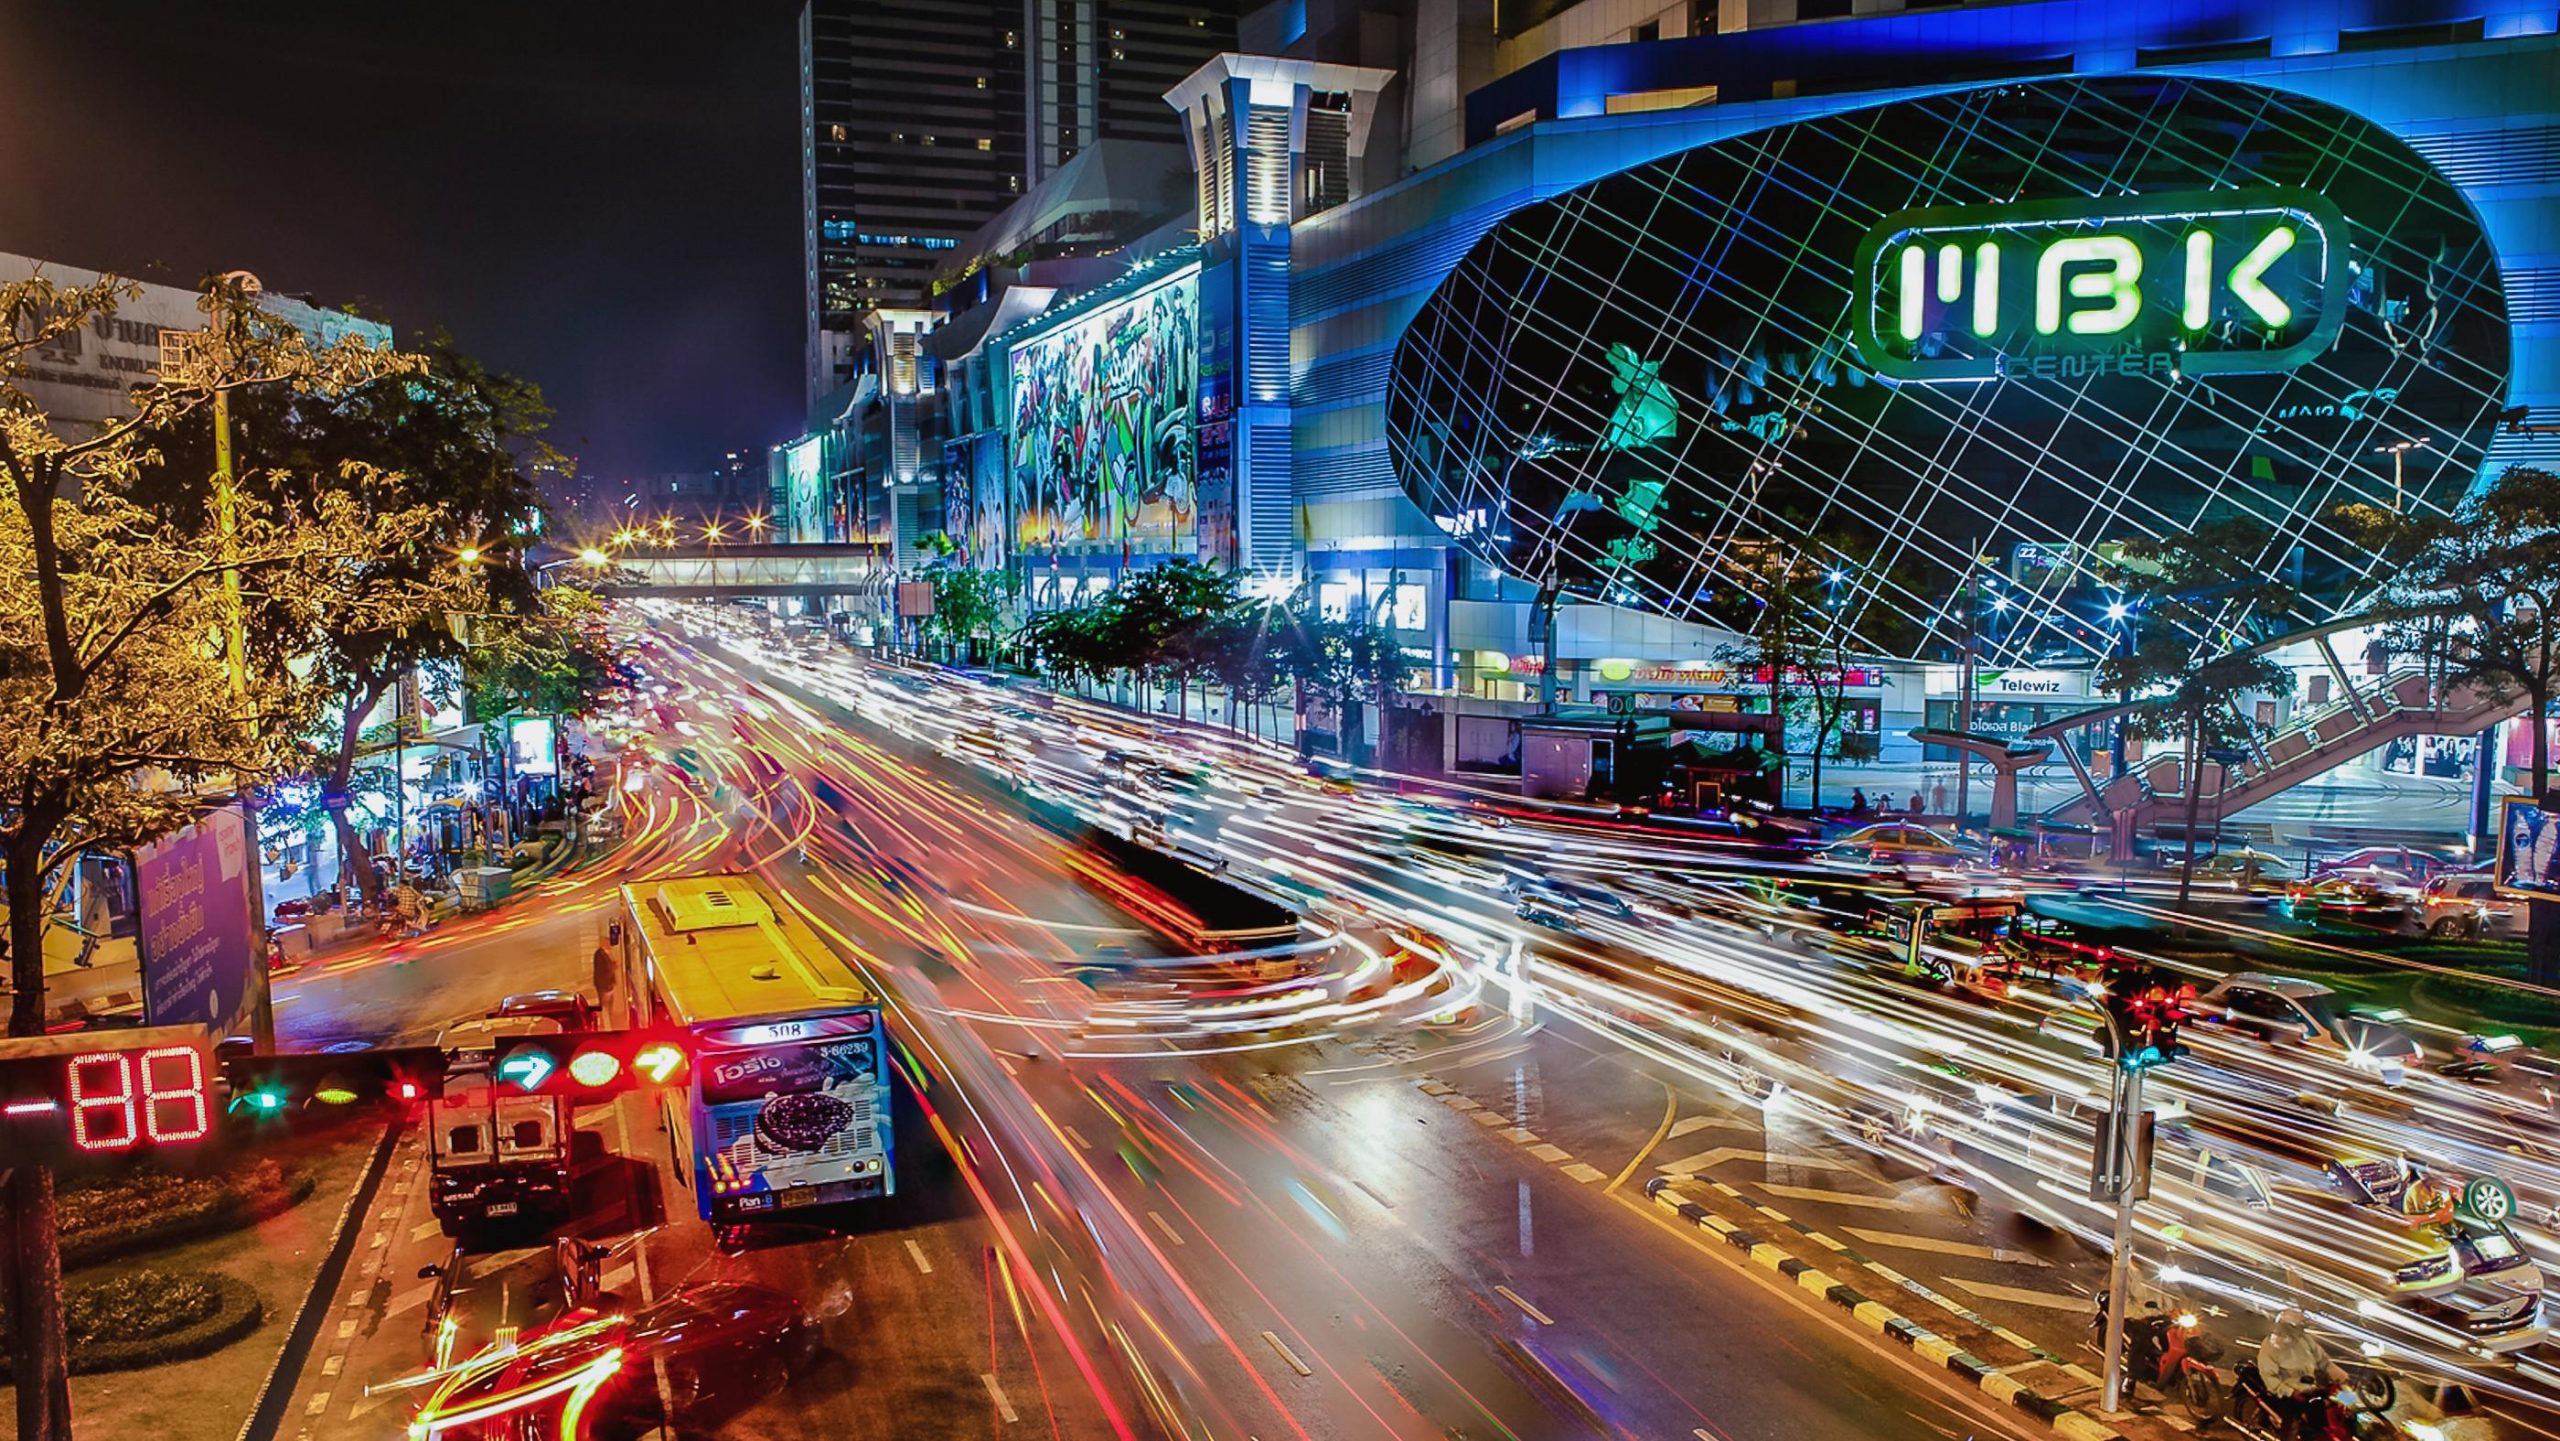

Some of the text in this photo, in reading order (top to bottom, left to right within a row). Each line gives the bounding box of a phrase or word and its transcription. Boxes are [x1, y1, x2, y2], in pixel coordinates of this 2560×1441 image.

[1899, 226, 2296, 342] MBK
[2003, 352, 2175, 380] CENTER
[2000, 679, 2060, 692] Telewiz
[443, 1193, 475, 1201] NISSAN
